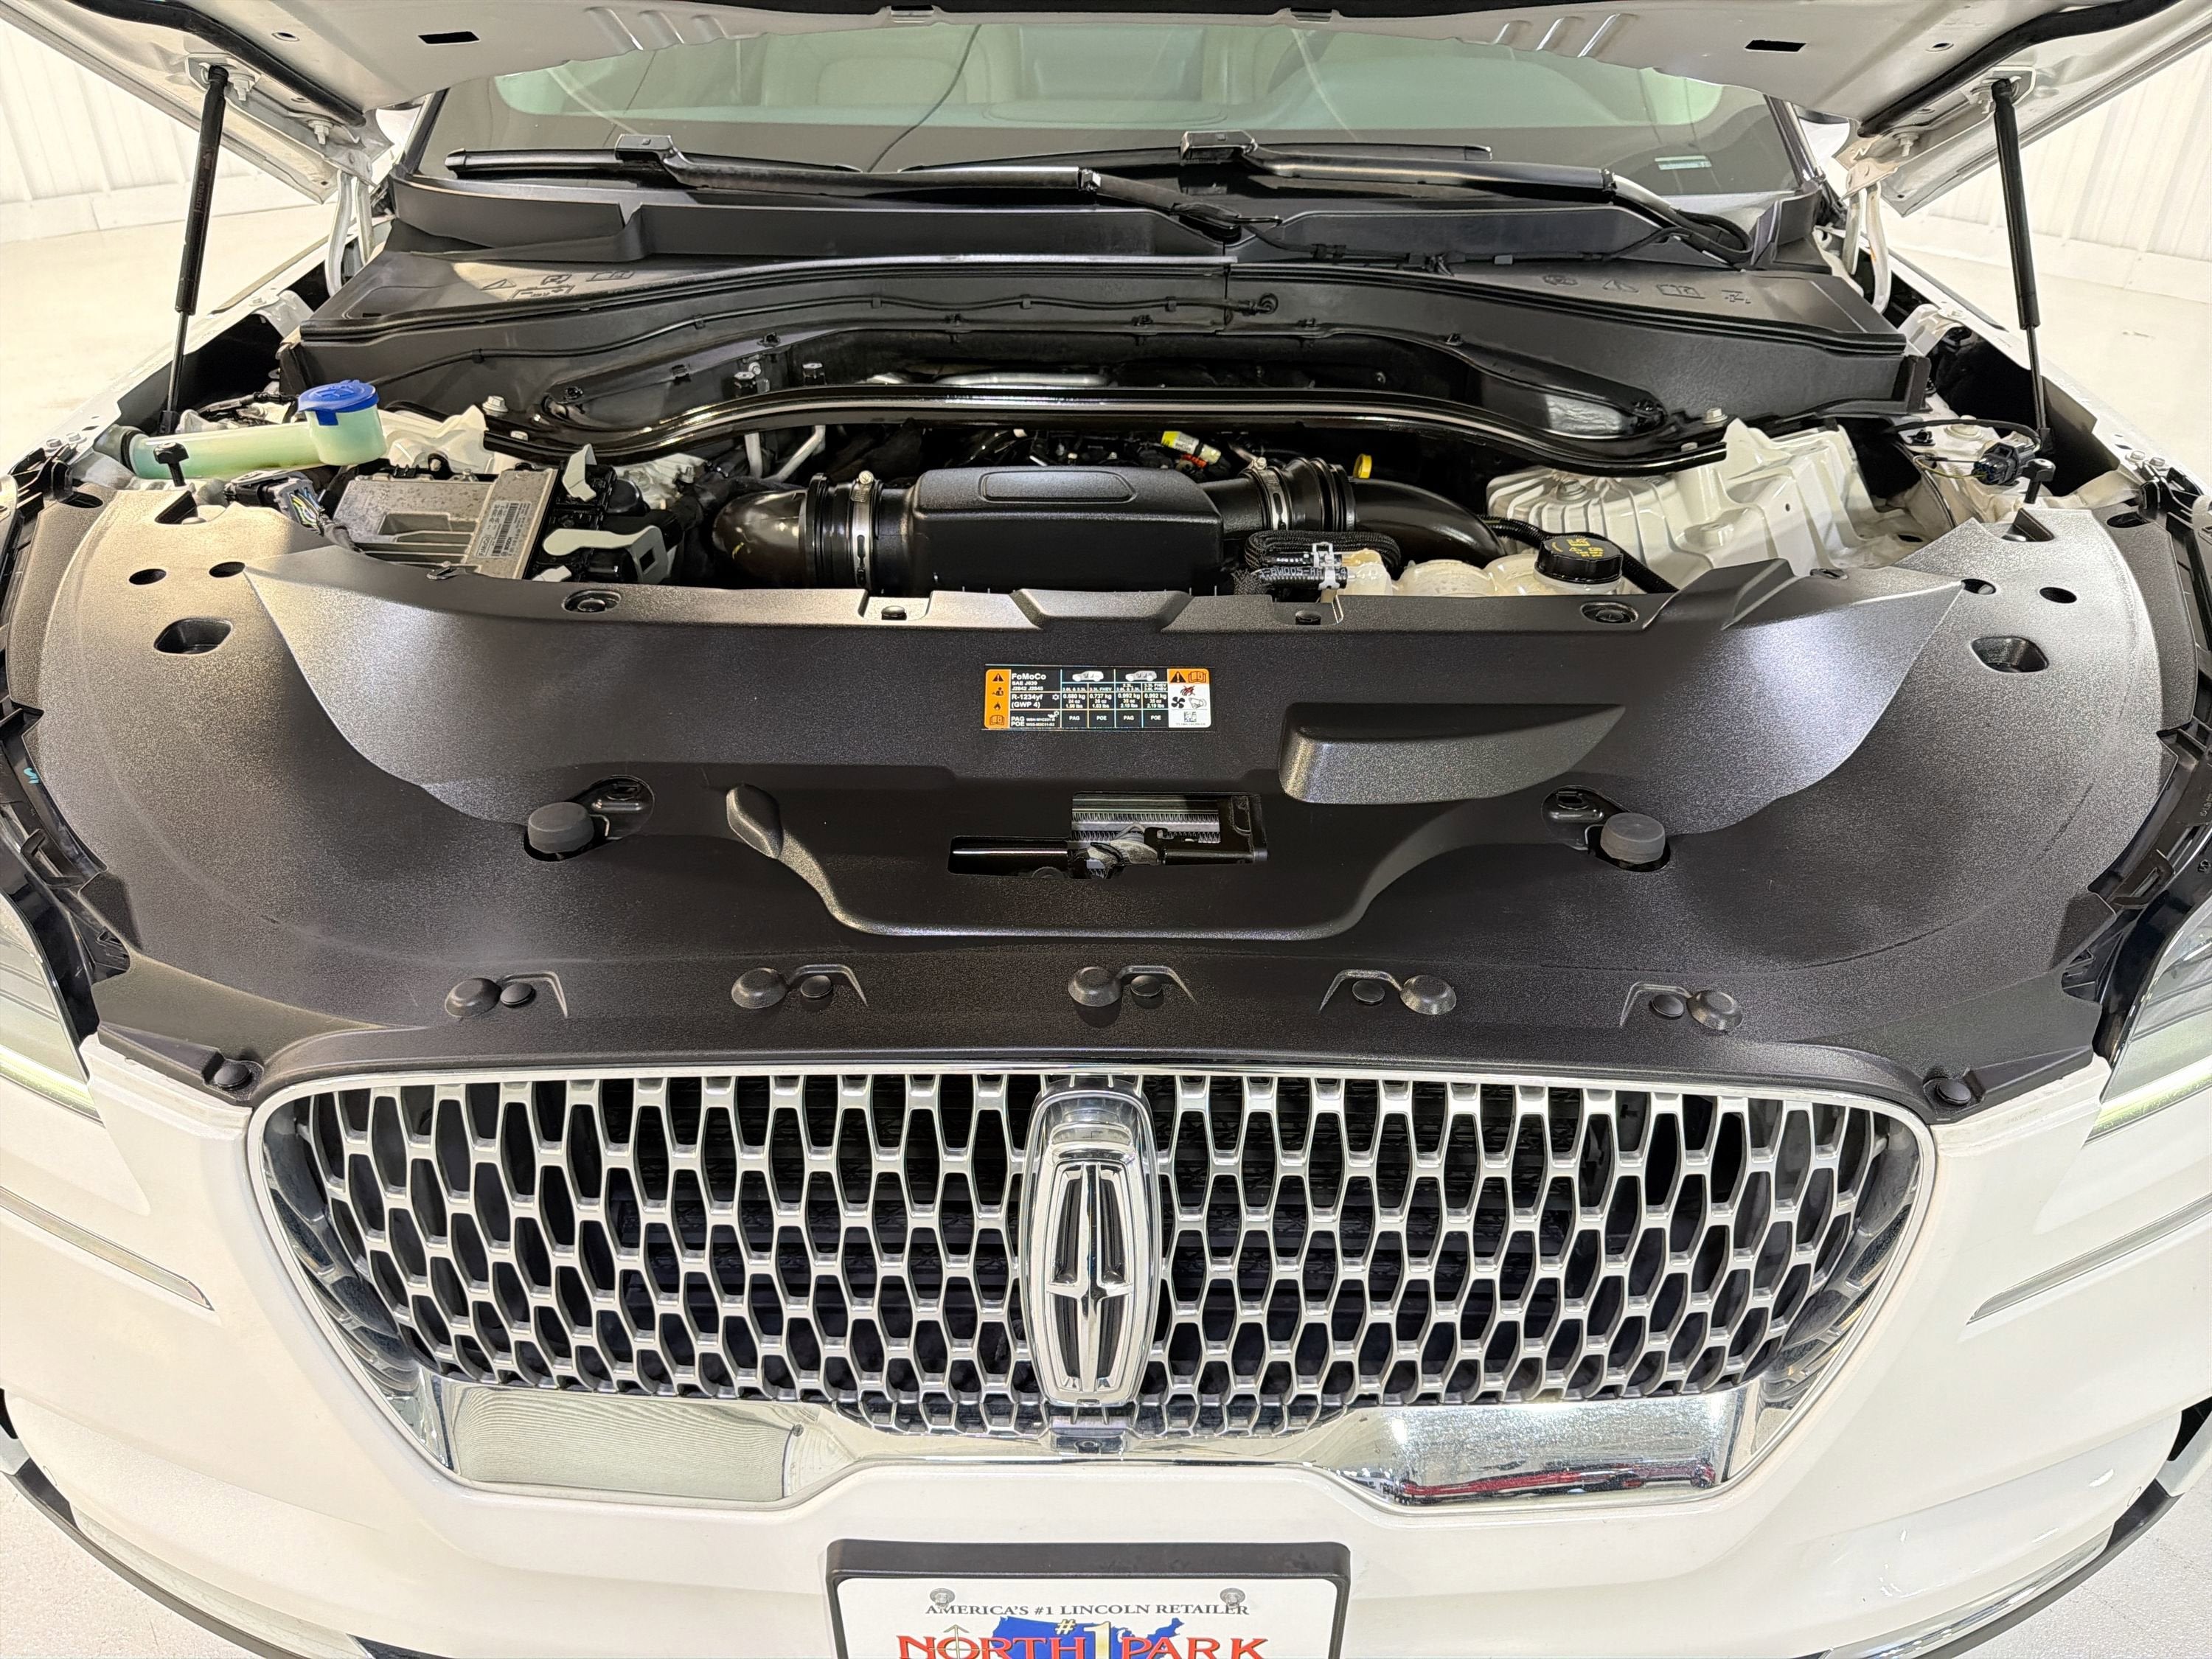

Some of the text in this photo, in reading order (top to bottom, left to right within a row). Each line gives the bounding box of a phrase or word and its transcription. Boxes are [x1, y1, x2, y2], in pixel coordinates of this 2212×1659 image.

[925, 1604, 1250, 1615] AMERICA'S #1 LINCOLN RETAILER
[897, 1635, 1268, 1659] NORTH PARK
